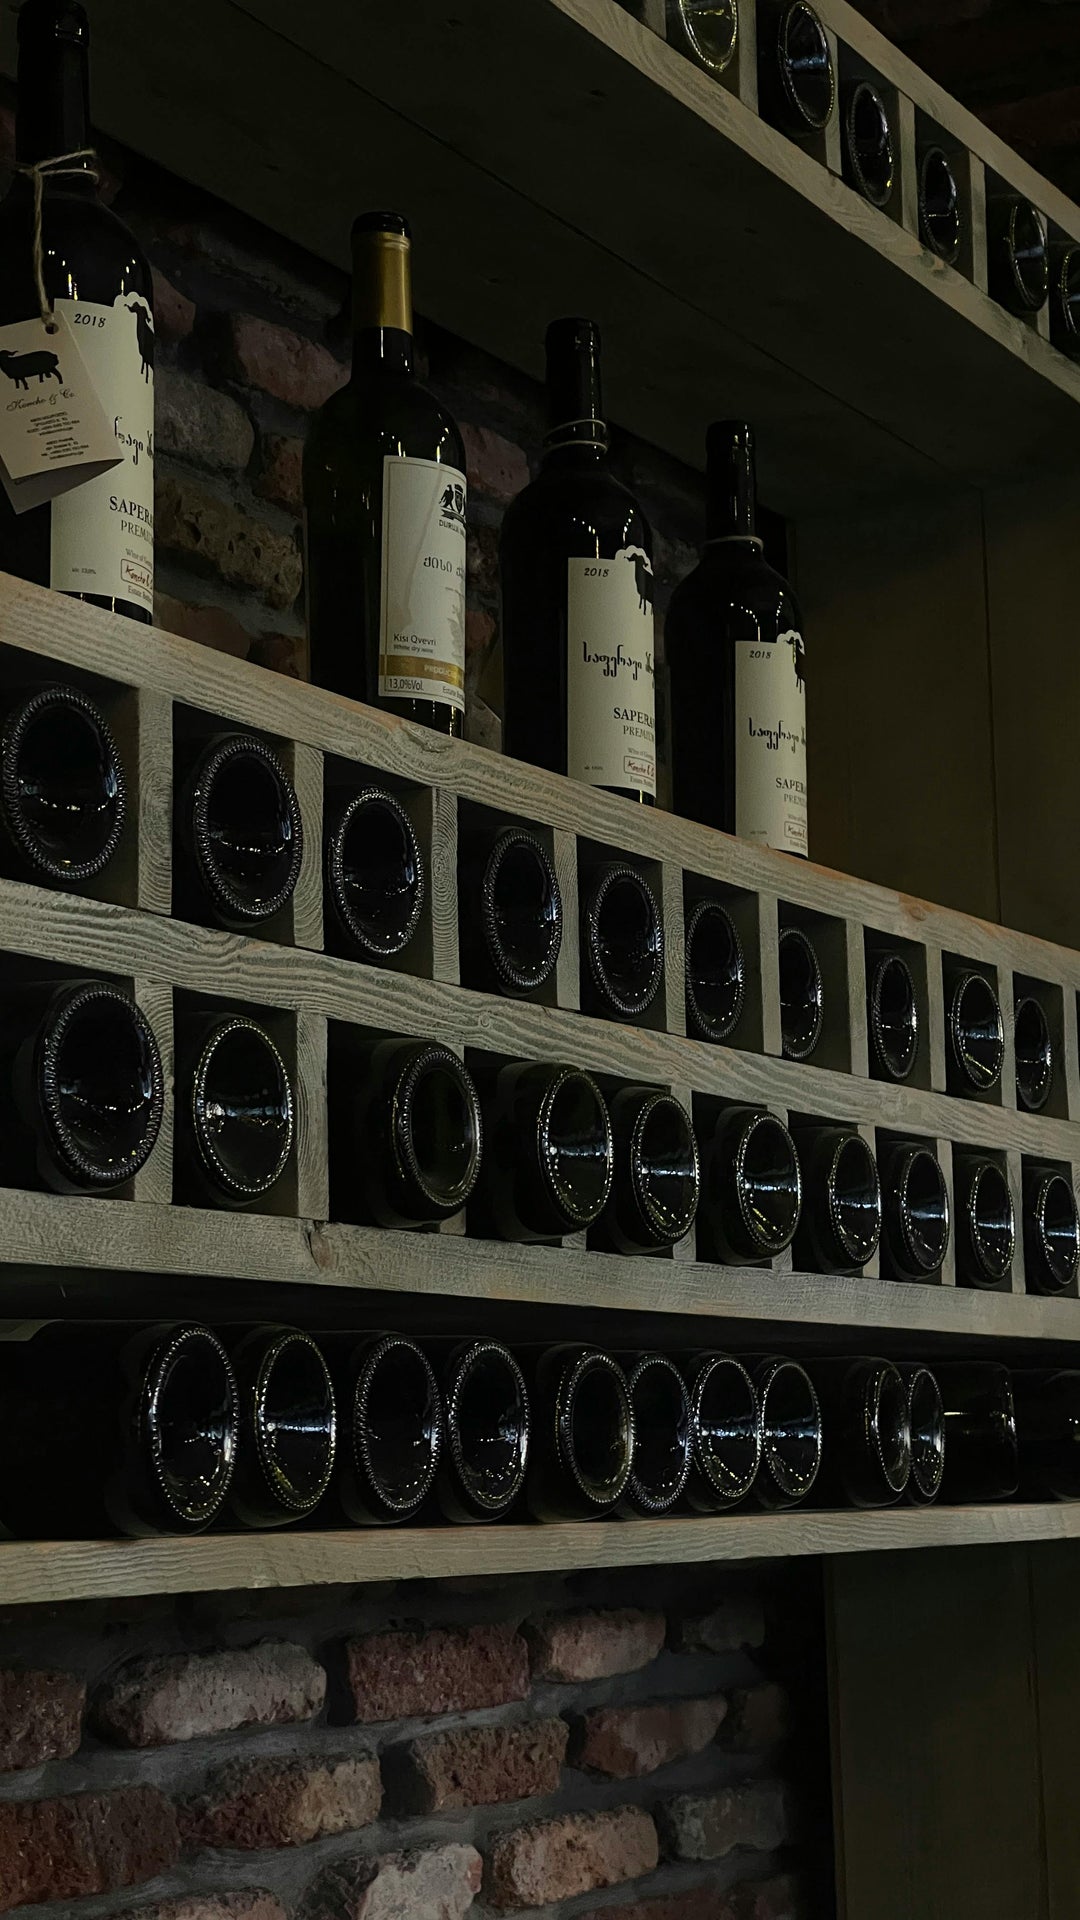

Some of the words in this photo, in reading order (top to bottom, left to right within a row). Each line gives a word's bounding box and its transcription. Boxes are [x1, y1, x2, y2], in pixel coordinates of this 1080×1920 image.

[74, 313, 107, 328] 2018
[583, 567, 610, 578] 2018
[393, 633, 409, 643] Kisi
[410, 634, 437, 646] Qvevri
[749, 650, 772, 659] 2018
